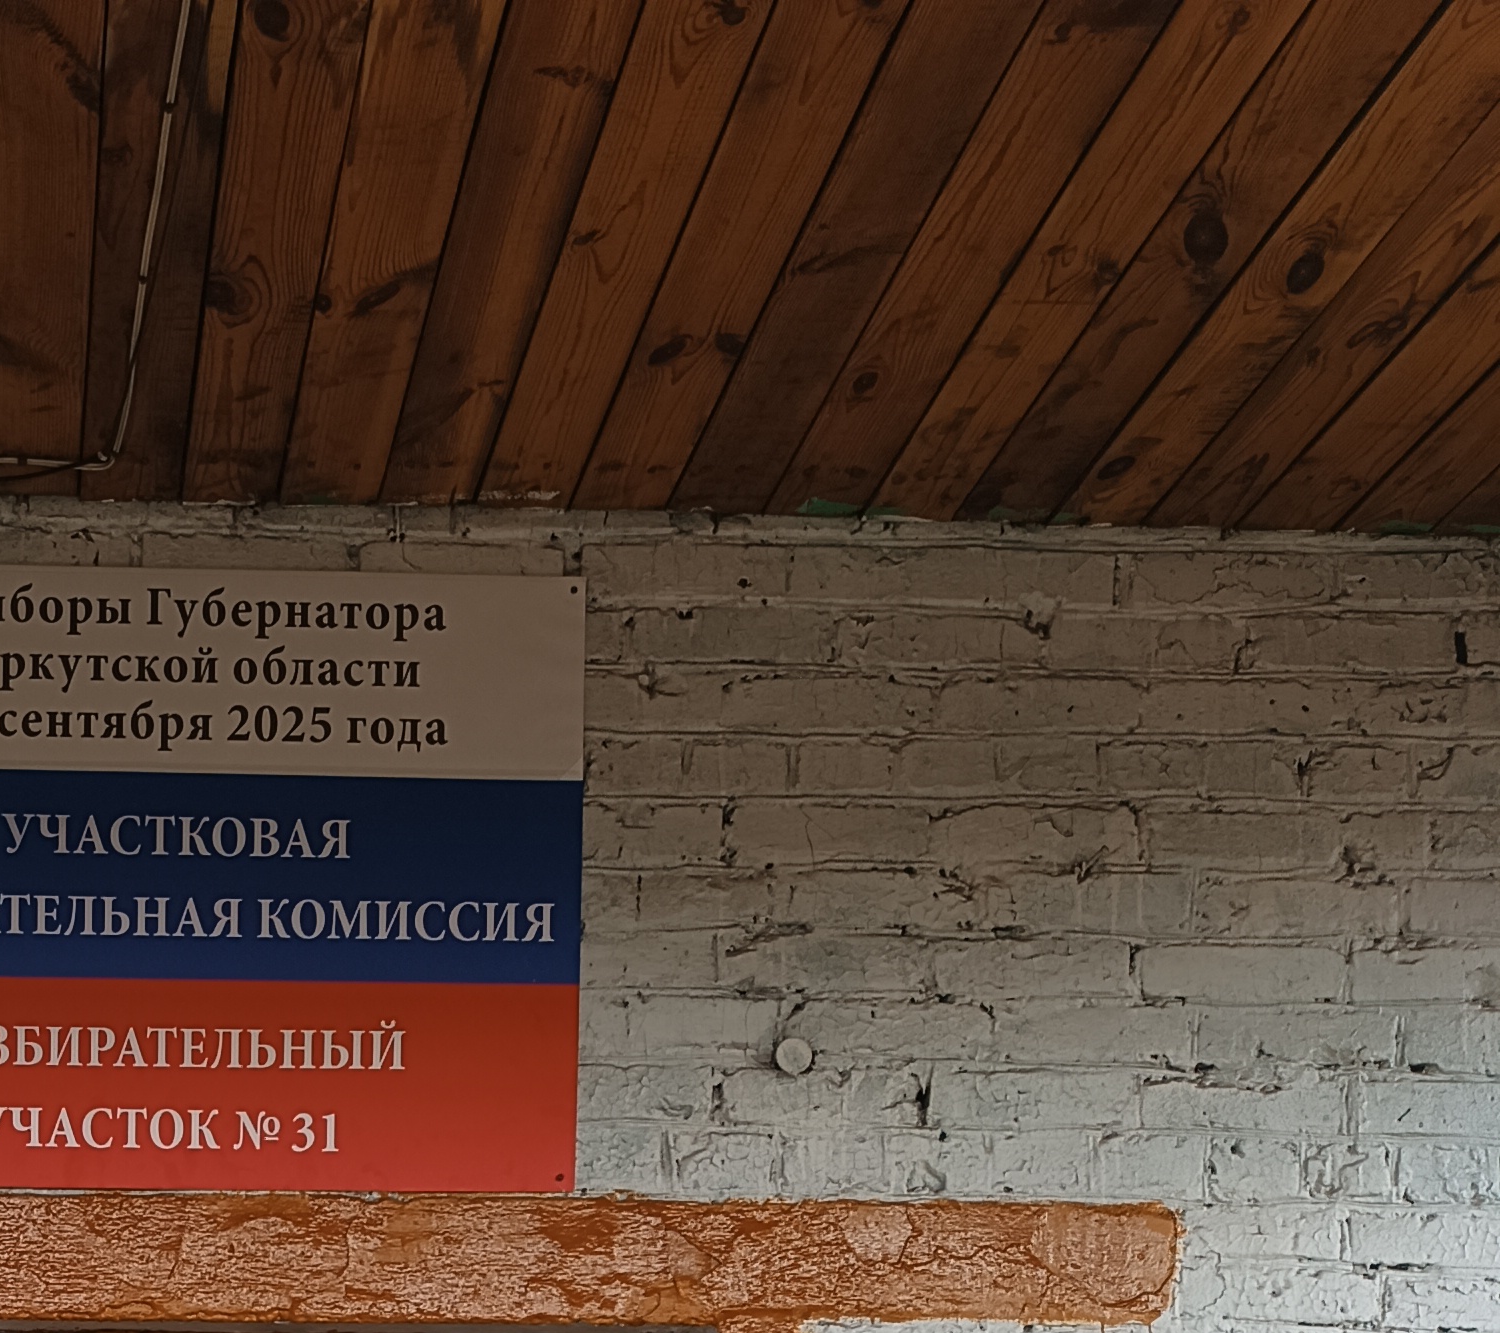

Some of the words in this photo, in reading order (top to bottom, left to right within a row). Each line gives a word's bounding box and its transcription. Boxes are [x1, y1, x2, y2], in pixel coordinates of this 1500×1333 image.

[147, 587, 446, 641] Губернатора
[234, 645, 420, 687] области
[227, 705, 331, 743] 2025
[347, 718, 448, 752] года
[2, 814, 350, 858] УЧАСТКОВАЯ
[257, 899, 555, 942] КОМИССИЯ
[233, 1111, 280, 1150] №
[292, 1113, 339, 1152] 31
